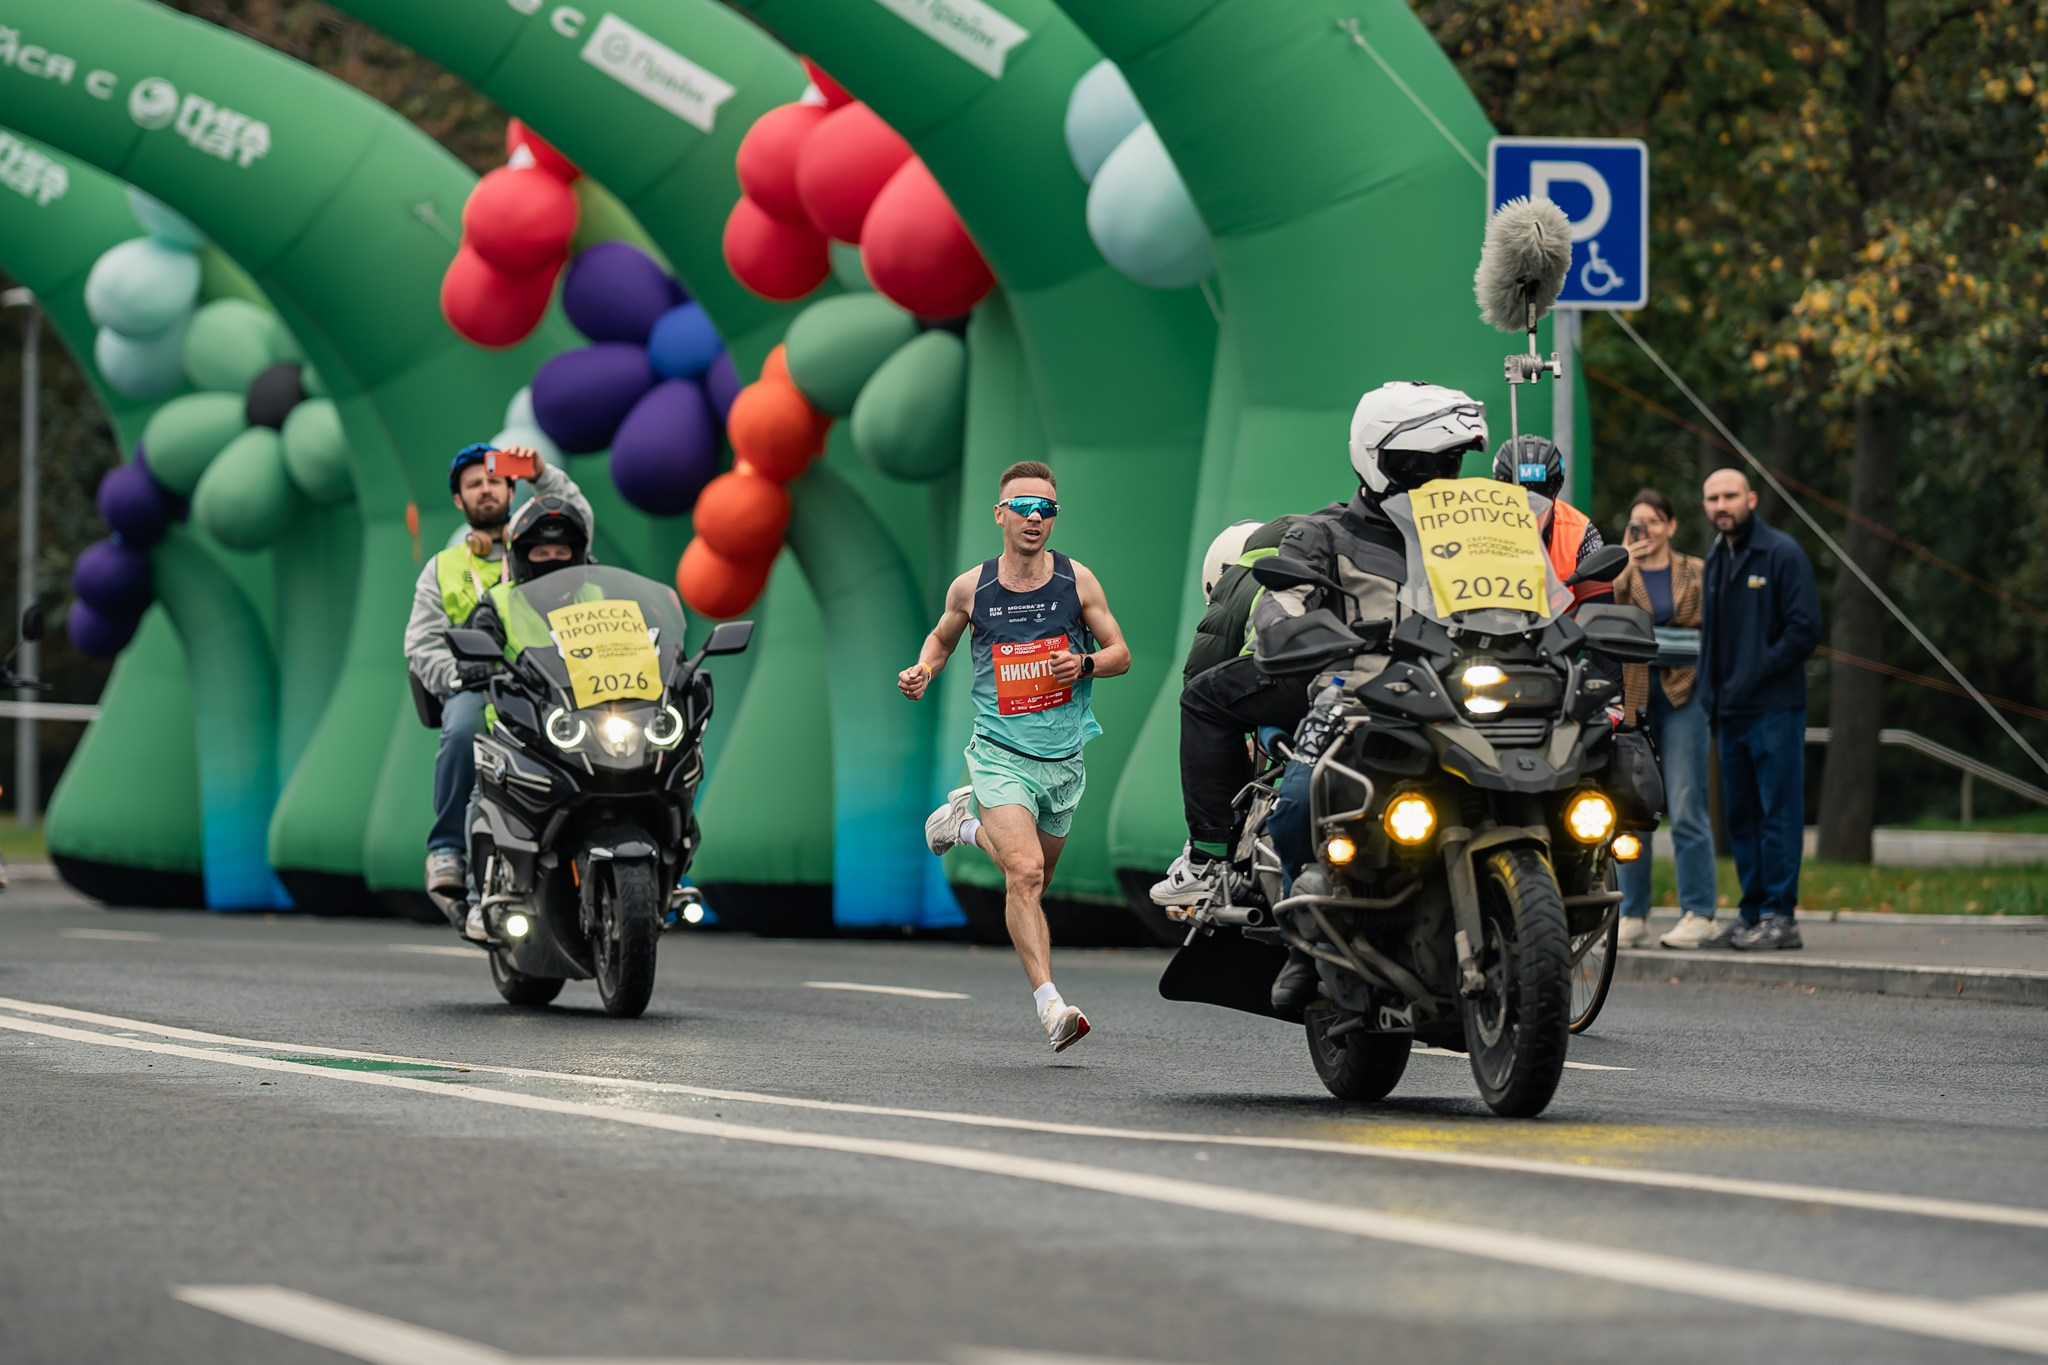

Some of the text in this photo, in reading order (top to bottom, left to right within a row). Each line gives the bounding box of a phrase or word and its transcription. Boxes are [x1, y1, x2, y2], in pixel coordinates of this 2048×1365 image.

[1530, 160, 1612, 243] P
[1425, 489, 1520, 509] ТРАССА
[1420, 508, 1532, 531] ПРОПУСК
[1451, 577, 1533, 600] 2026
[562, 608, 633, 626] ТРАССА
[559, 621, 644, 640] ПРОПУСК
[588, 672, 648, 694] 2026
